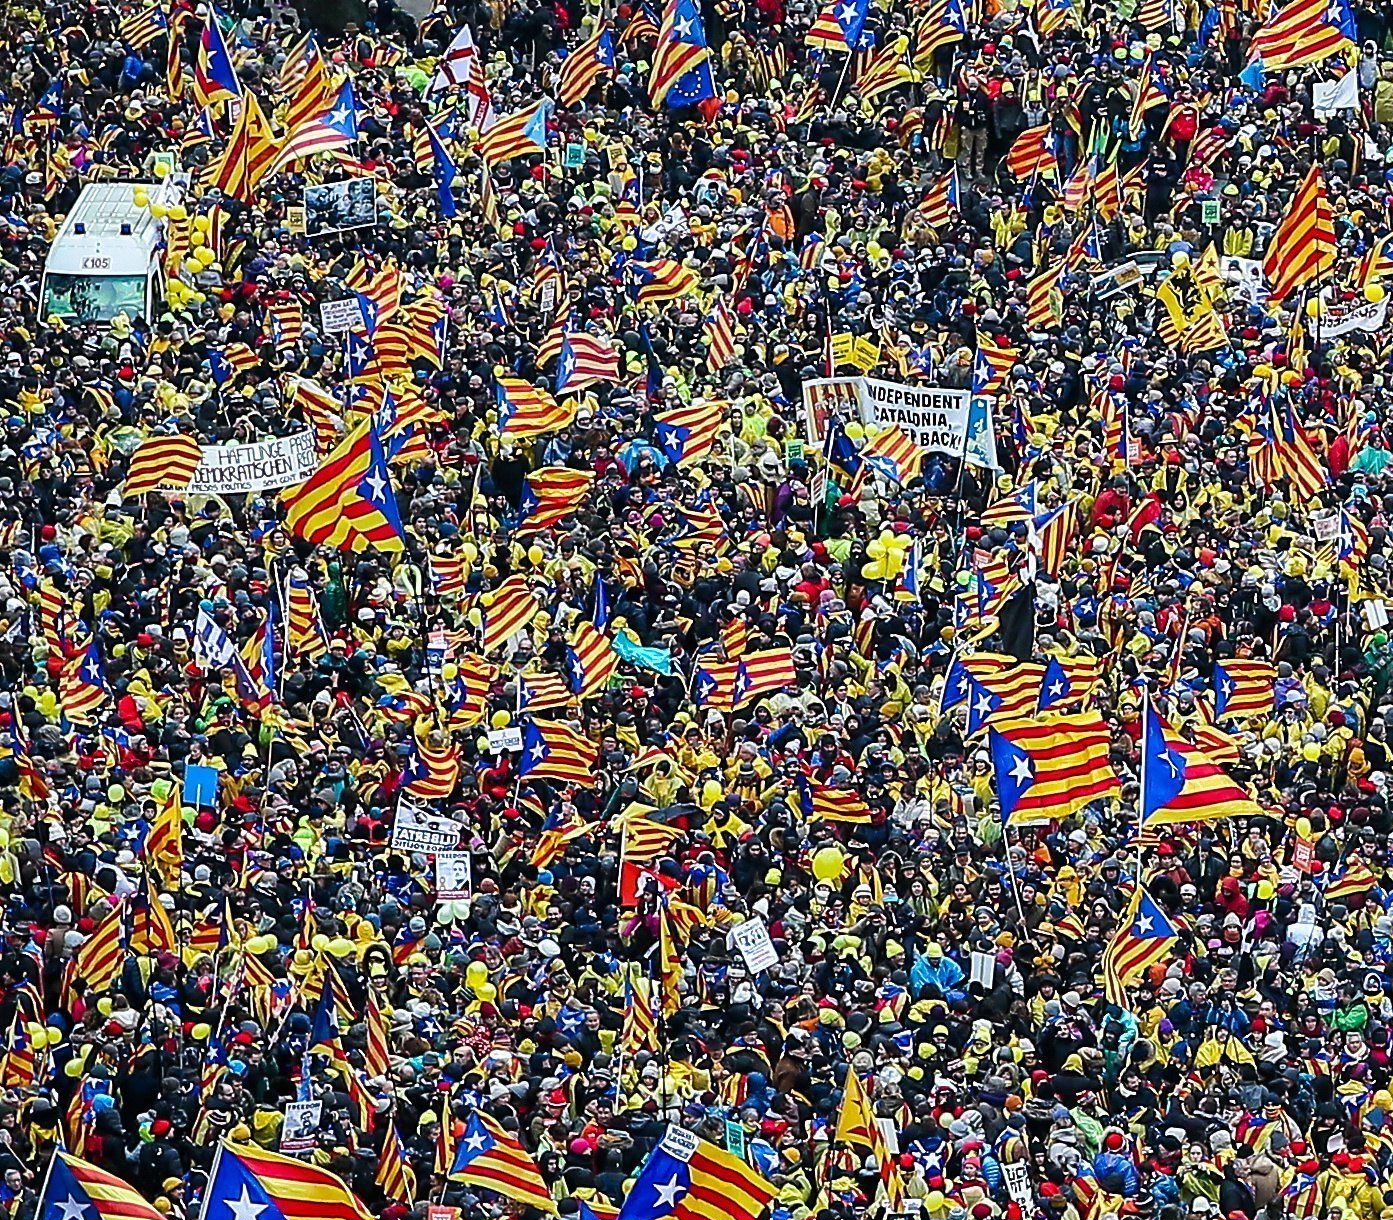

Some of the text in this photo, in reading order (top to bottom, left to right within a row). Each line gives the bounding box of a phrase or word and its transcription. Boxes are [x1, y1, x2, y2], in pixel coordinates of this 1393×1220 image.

[867, 384, 963, 411] NDEPENDENT
[920, 427, 962, 452] BACK!
[287, 1103, 321, 1112] FREEDOM
